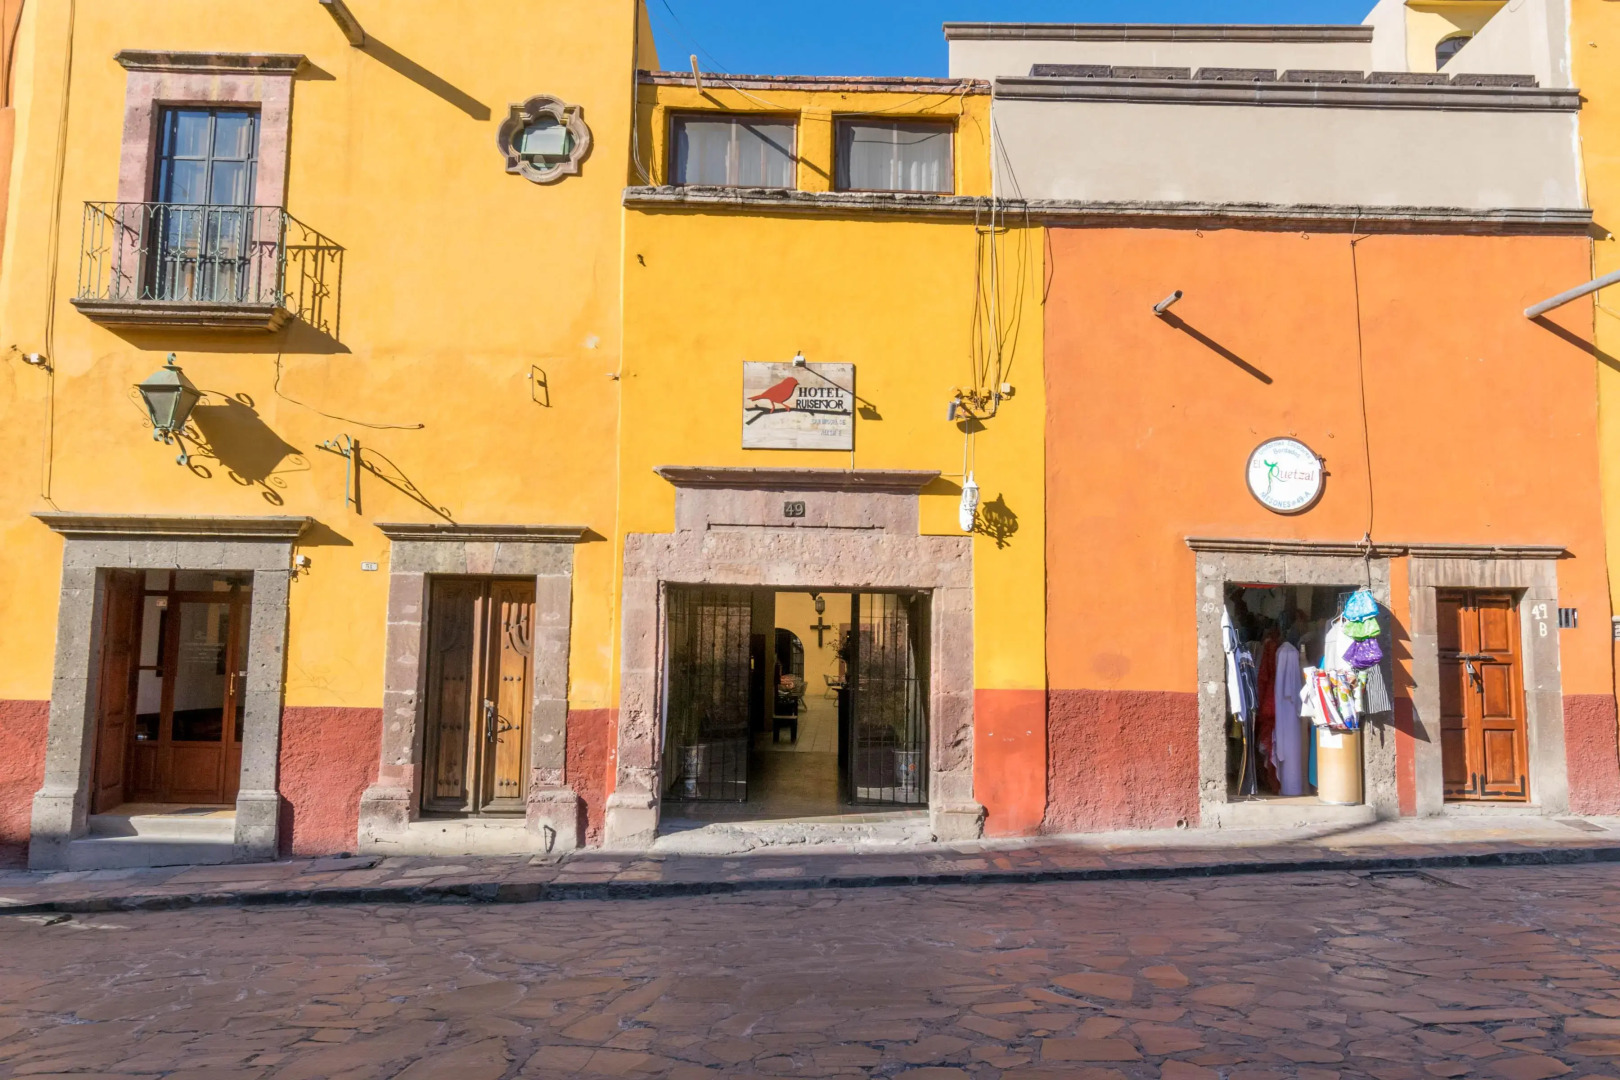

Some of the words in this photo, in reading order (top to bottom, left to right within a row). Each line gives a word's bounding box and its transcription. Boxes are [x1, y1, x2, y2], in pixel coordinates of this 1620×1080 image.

[798, 387, 844, 398] HOTEL
[1271, 465, 1315, 482] Quetzal
[785, 503, 804, 516] 49
[1531, 603, 1548, 620] 49
[1539, 621, 1548, 637] B
